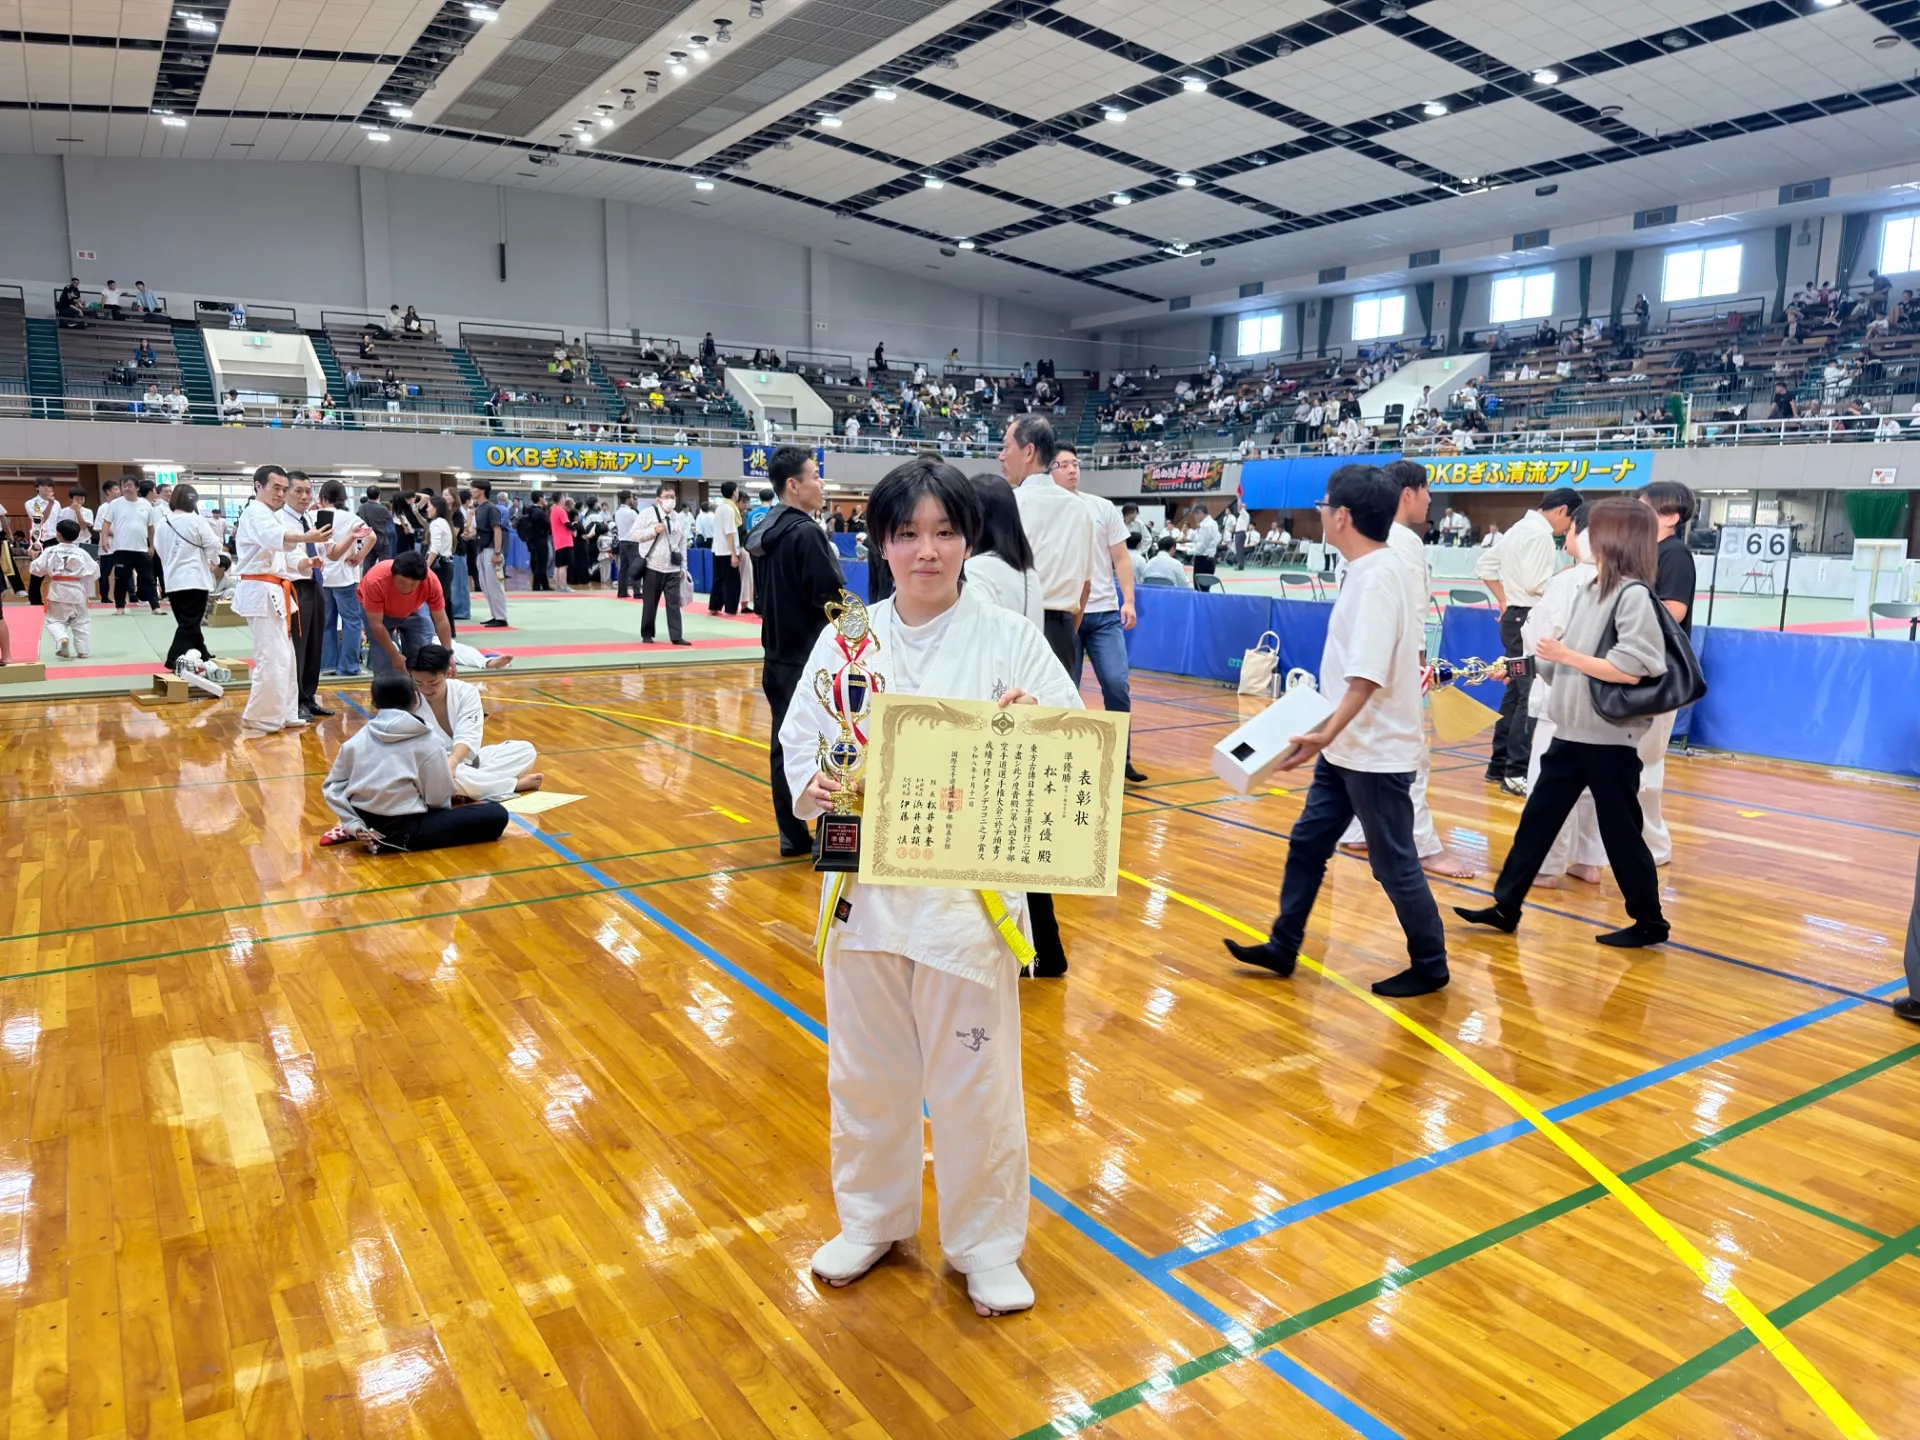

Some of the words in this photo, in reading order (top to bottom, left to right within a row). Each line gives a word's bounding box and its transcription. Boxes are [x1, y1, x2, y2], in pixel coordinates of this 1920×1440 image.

[486, 445, 690, 474] OKBぎふ清流アリーナ
[1044, 765, 1058, 794] 松本
[1062, 751, 1074, 783] 準優勝
[1074, 769, 1092, 826] 表彰状
[1039, 812, 1054, 843] 美優
[1037, 850, 1052, 863] 殿
